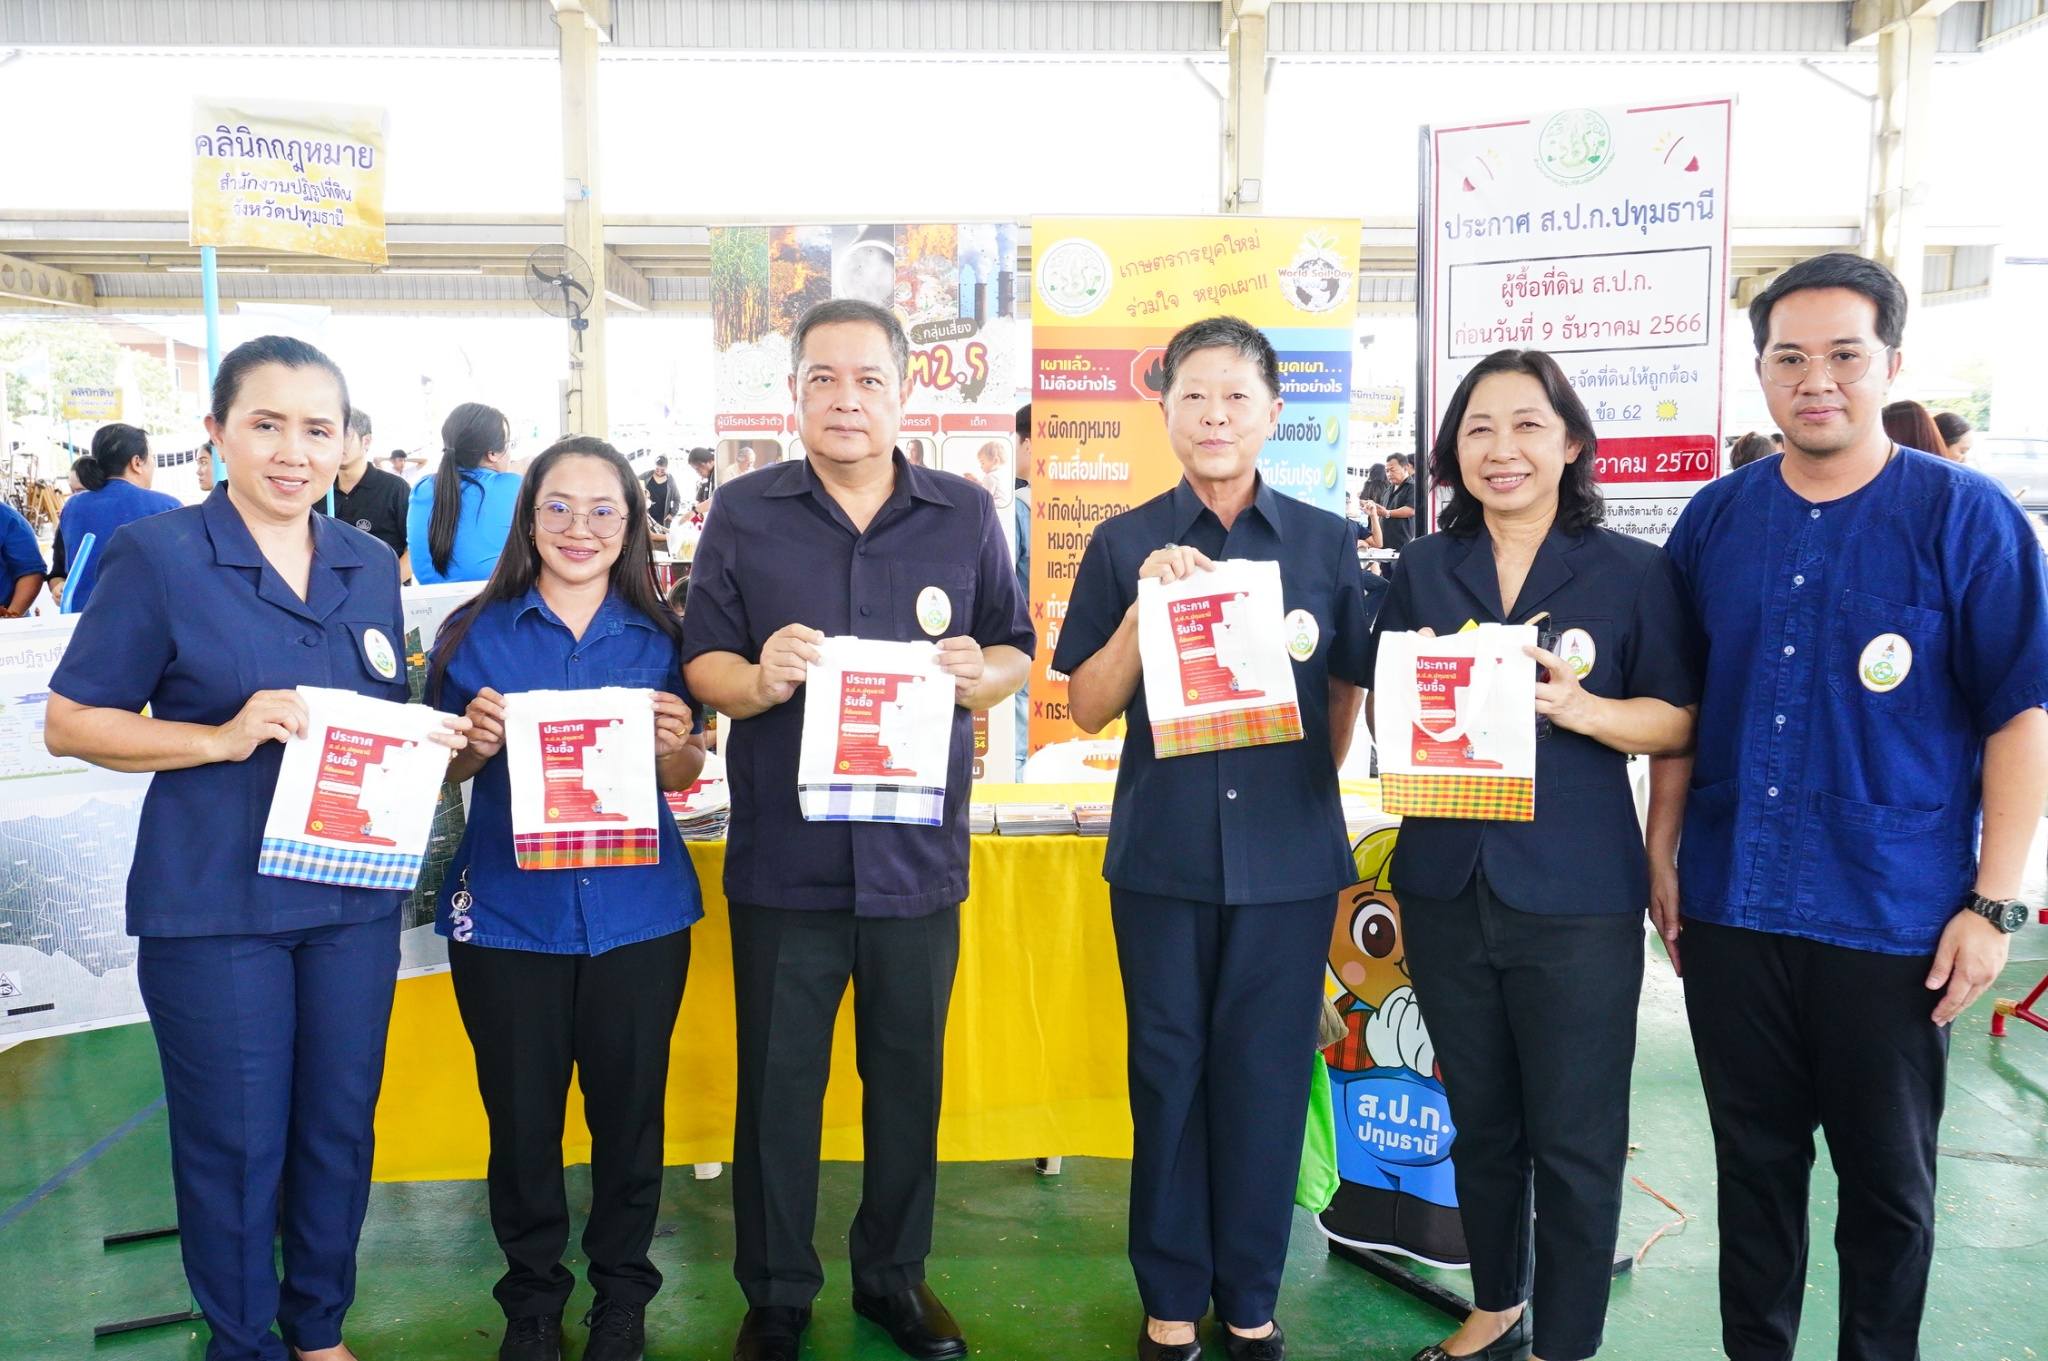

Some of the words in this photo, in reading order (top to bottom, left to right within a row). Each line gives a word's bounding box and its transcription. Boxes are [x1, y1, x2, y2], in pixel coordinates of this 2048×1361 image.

[195, 125, 375, 173] คลินิกกฎหมาย
[220, 172, 353, 203] สำนักงานปฏิรูปที่ดิน
[233, 199, 345, 228] จังหวัดปทุมธานี
[1445, 211, 1530, 240] ประกาศ
[1541, 188, 1714, 236] ส.ป.ก.ปทุมธานี
[1119, 228, 1261, 279] เกษตรกรยุคใหม่
[1278, 269, 1308, 278] World
[1592, 270, 1652, 293] ส.ป.ก.
[1126, 290, 1179, 318] ร่วมใจ
[923, 318, 973, 340] กลุ่มเสี่ยง
[1455, 312, 1534, 345] ก่อนวันที่
[1543, 322, 1554, 341] 9
[1561, 315, 1640, 340] ธันวาคม
[1649, 313, 1701, 335] 2566
[1278, 361, 1343, 376] ยุดเผา...
[1569, 364, 1698, 391] รจัดที่ดินให้ถูกต้อง
[1039, 374, 1117, 392] ไม่ดีอย่างไร
[1596, 401, 1616, 420] ข้อ
[1623, 405, 1642, 419] 62
[1047, 414, 1121, 446] ผิดกฎหมาย
[1048, 448, 1130, 481] ดินเสื่อมโทรม
[1595, 456, 1647, 474] วาคม
[1655, 452, 1709, 473] 2570
[1666, 506, 1679, 516] 62
[1172, 601, 1210, 613] ประกาศ
[846, 674, 886, 686] ประกาศ
[1046, 702, 1070, 720] กระ
[331, 730, 374, 747] ประกาศ
[543, 724, 584, 734] ประกาศ
[1358, 1094, 1450, 1134] ส.ป.ก.
[1358, 1122, 1438, 1156] ปทุมธานี
